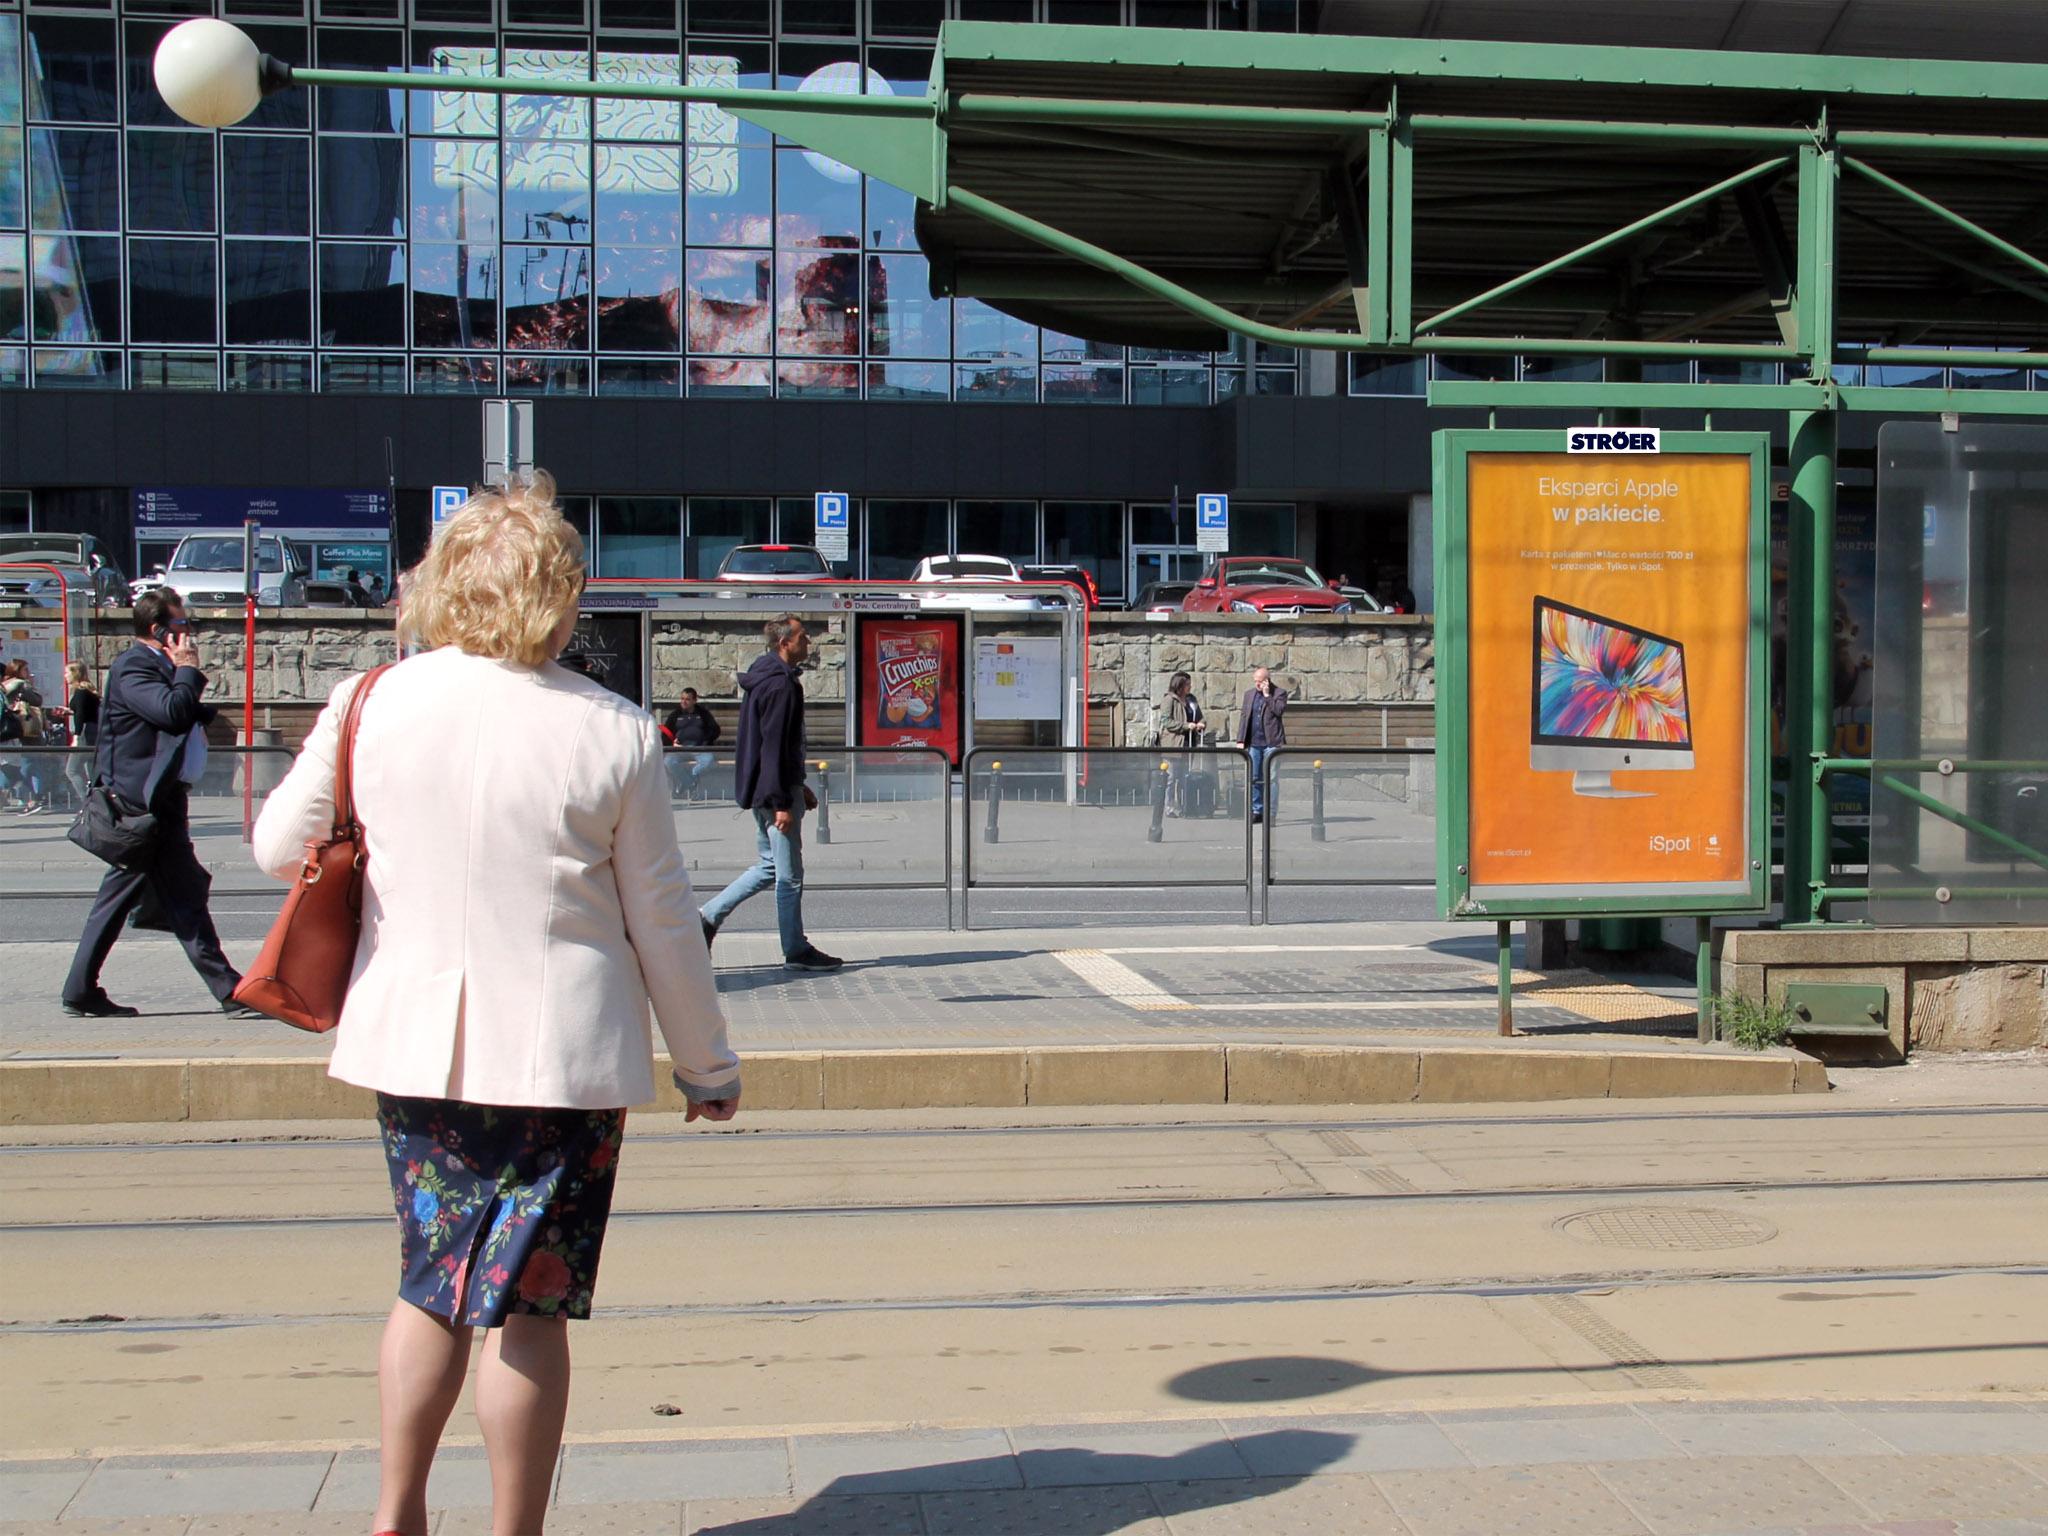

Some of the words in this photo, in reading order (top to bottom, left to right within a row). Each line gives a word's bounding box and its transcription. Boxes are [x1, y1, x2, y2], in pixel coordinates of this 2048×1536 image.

[1571, 431, 1656, 450] STRÖER
[1538, 477, 1619, 499] Eksperci
[1623, 478, 1679, 500] Apple
[440, 490, 460, 518] P
[822, 497, 842, 524] P
[1203, 498, 1222, 524] P
[1552, 507, 1570, 522] w
[1575, 503, 1665, 525] pakiecie.
[1665, 551, 1683, 560] 700
[872, 602, 909, 611] Centralny
[885, 657, 938, 685] Crunchips
[1649, 835, 1691, 855] iSpot
